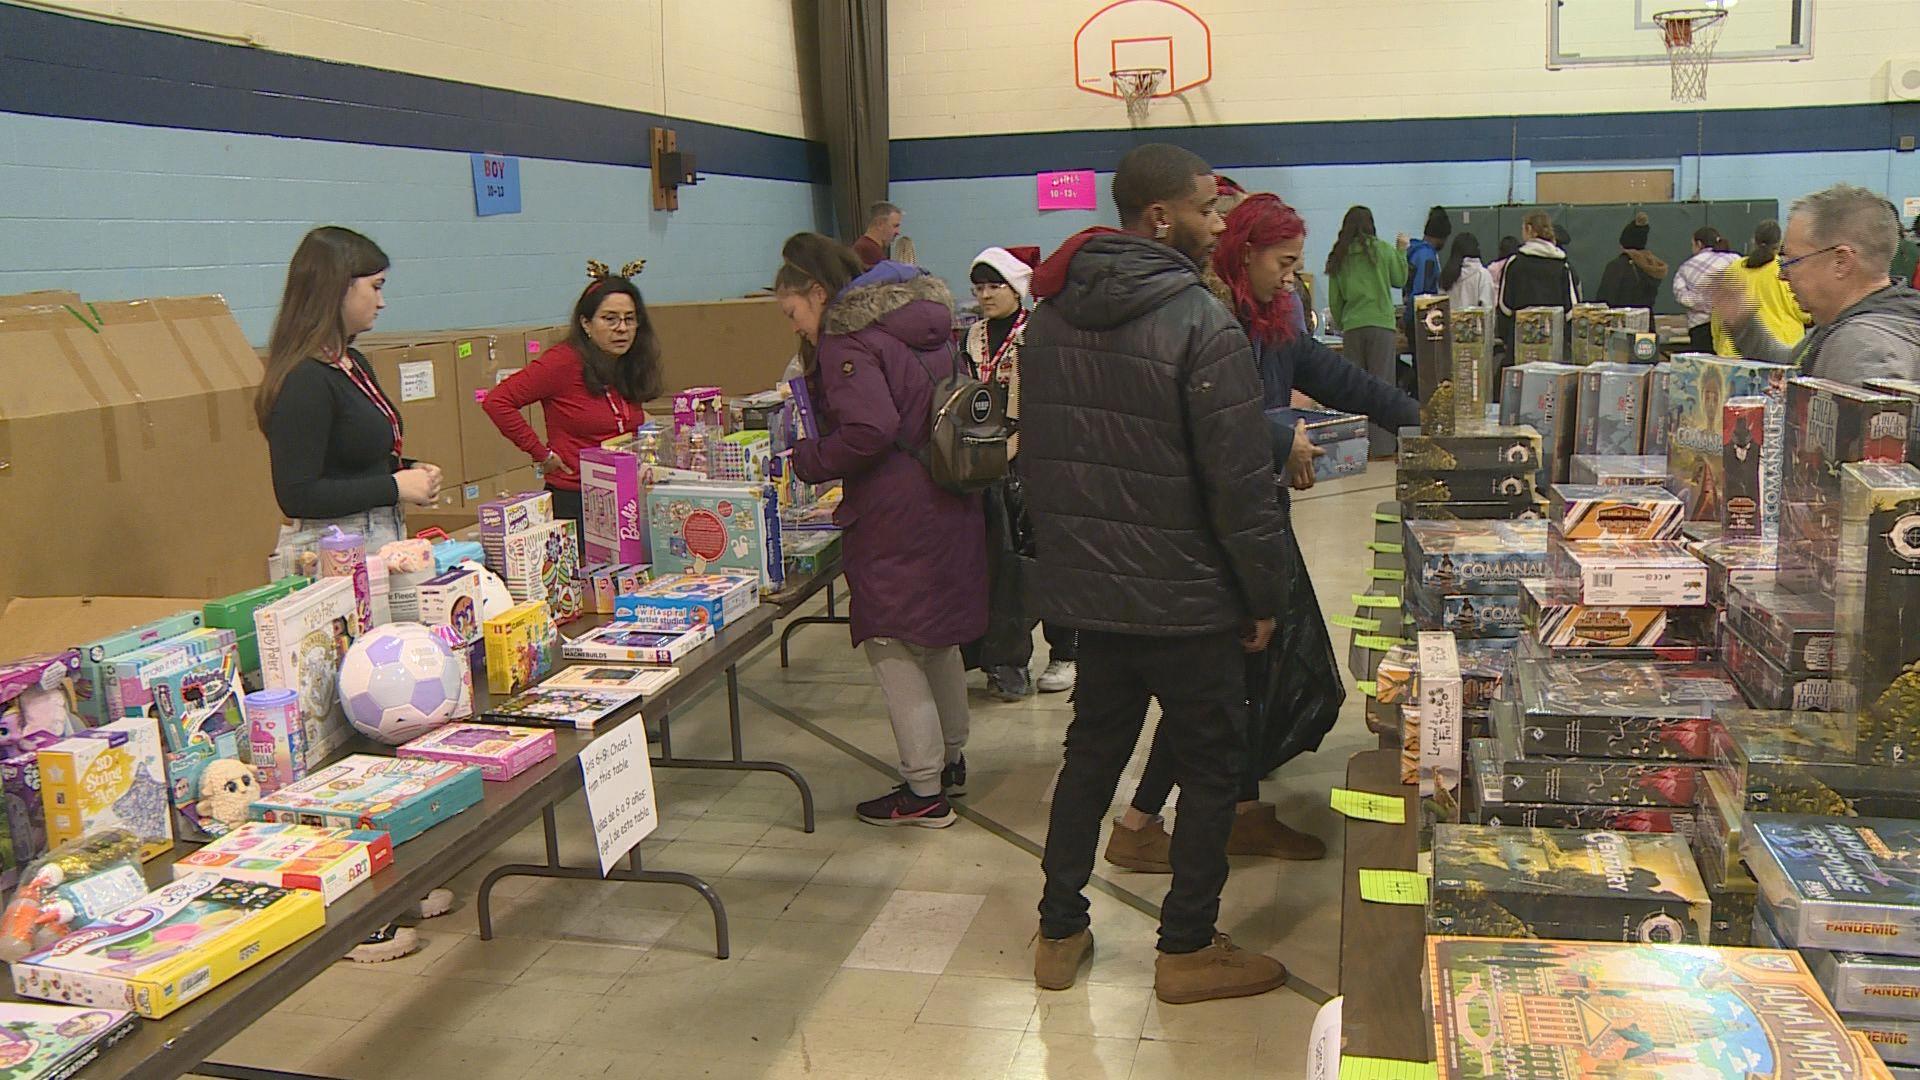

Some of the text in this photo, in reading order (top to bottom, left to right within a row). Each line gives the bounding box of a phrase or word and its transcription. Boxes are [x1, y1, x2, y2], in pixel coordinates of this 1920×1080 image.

[484, 159, 504, 179] BOY
[1676, 427, 1723, 456] COMANA
[1764, 404, 1787, 514] COMANAUTS
[621, 499, 640, 540] Barbie
[1460, 561, 1551, 580] COMANAU
[261, 624, 280, 672] Harry Potter
[564, 651, 607, 660] MAGNEBUILDS
[96, 754, 112, 770] 3D
[86, 768, 124, 792] String
[1825, 824, 1873, 862] RAPID
[348, 858, 368, 882] ART
[1584, 832, 1629, 892] CENTURY
[1800, 825, 1872, 895] RESPONSE
[1825, 920, 1899, 936] PANDEMIC
[1863, 984, 1920, 999] PANDEM
[1752, 985, 1825, 1025] ALMA
